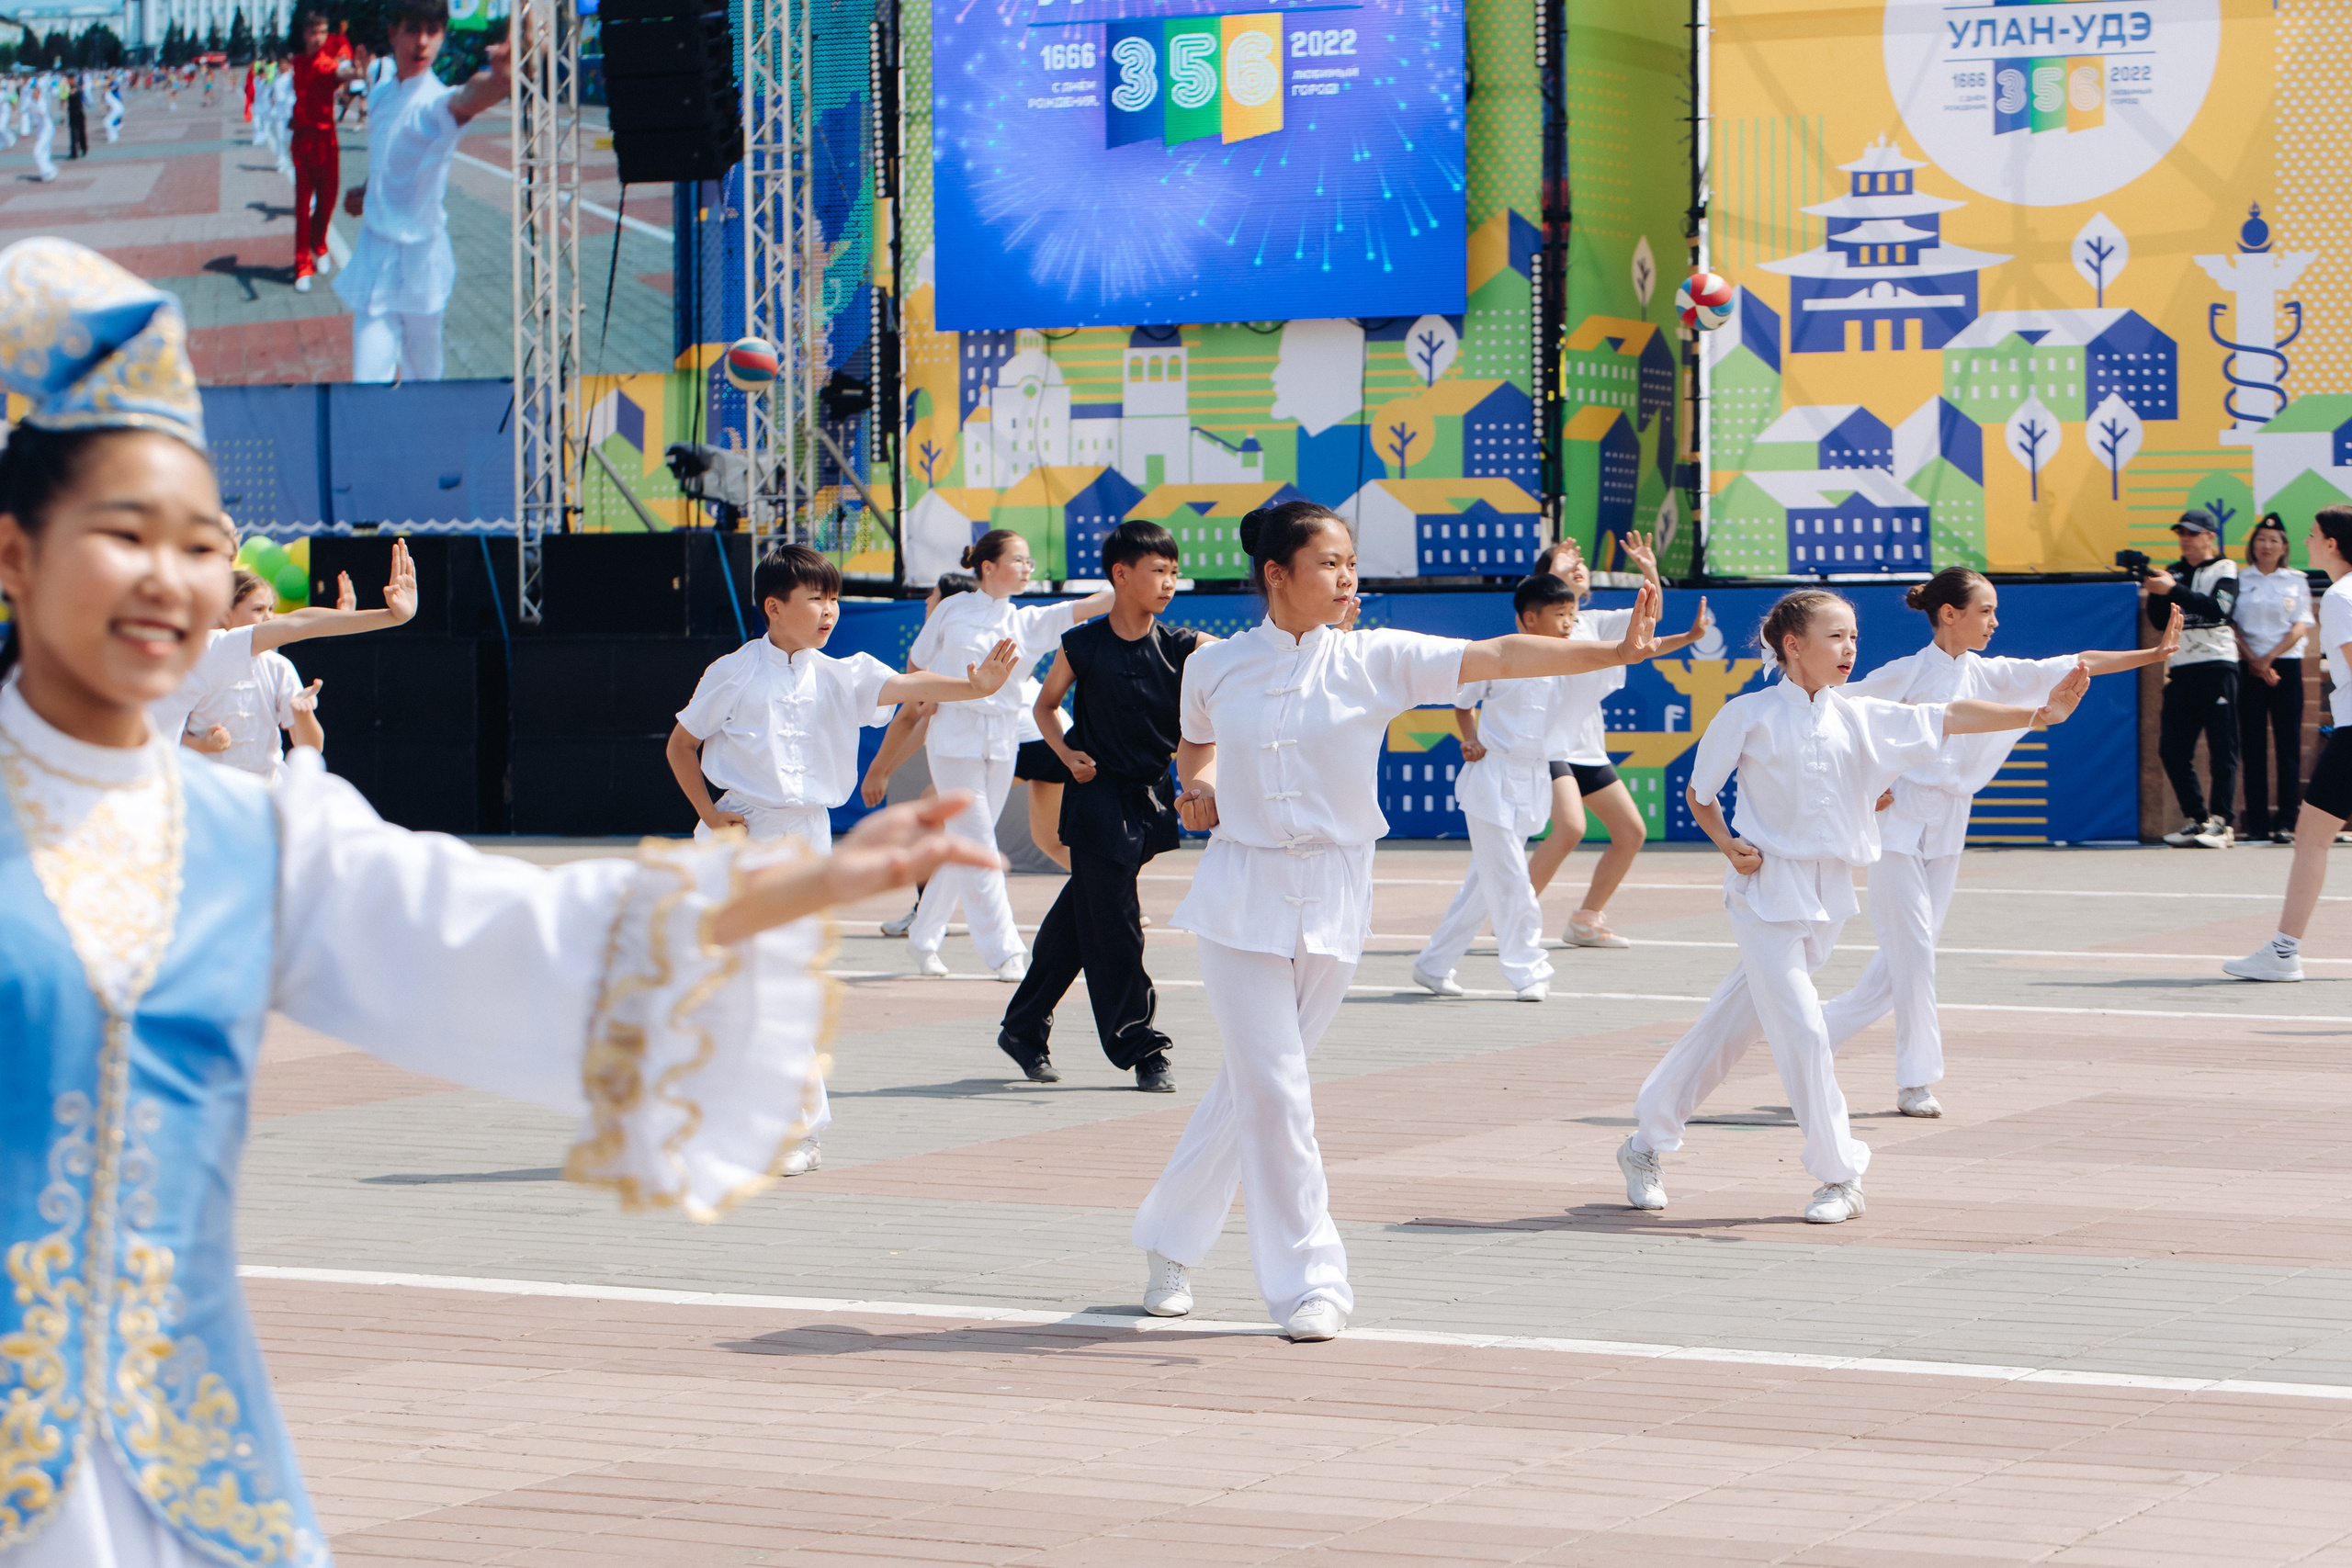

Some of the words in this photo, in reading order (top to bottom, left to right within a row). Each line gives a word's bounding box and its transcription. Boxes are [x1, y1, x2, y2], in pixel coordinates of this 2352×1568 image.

[1289, 28, 1357, 58] 2022
[1947, 11, 2152, 49] УЛАН-УДЭ
[1040, 43, 1096, 71] 1666
[1112, 30, 1279, 112] 356
[1951, 72, 1986, 88] 1666
[2110, 65, 2152, 82] 2022
[1996, 66, 2103, 115] 356
